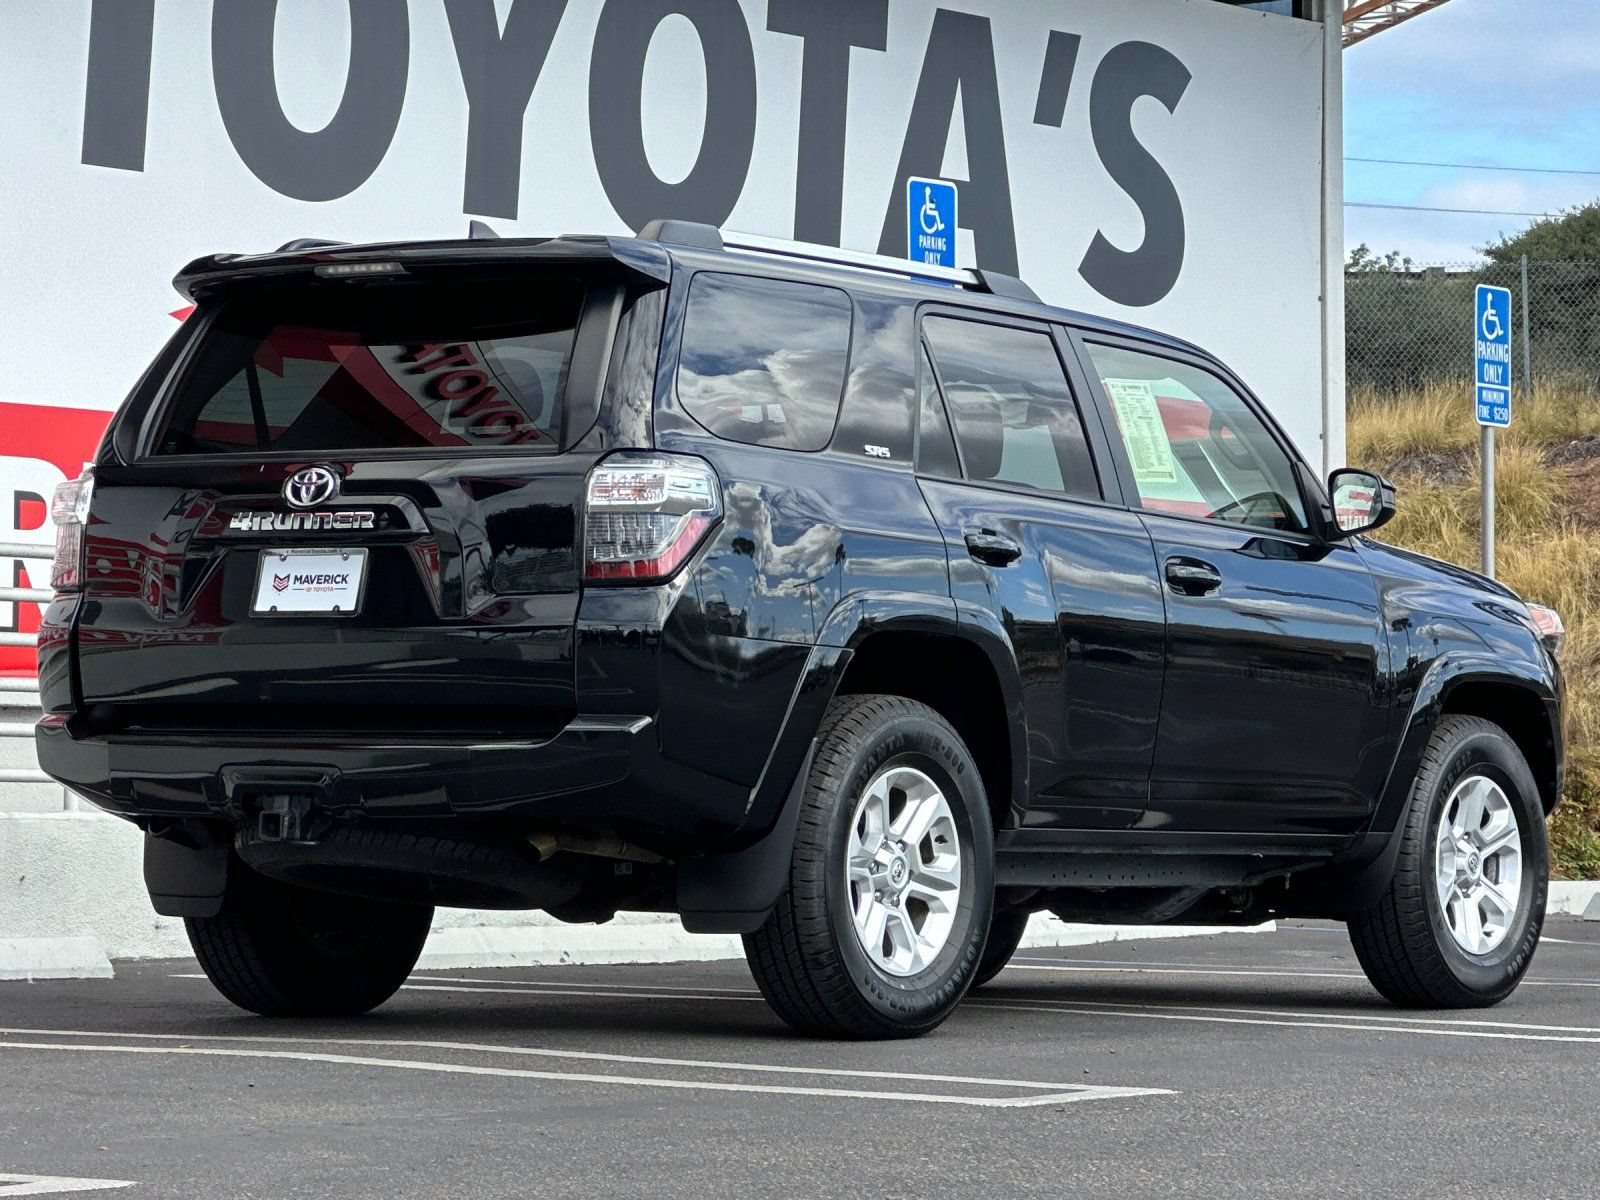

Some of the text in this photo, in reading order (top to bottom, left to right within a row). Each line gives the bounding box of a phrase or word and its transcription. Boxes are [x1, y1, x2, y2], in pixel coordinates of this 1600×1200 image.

[919, 234, 947, 252] PARKING
[924, 251, 941, 266] ONLY
[1478, 341, 1509, 363] PARKING
[1484, 363, 1503, 384] ONLY
[1482, 389, 1505, 405] MINIMUM
[1478, 404, 1508, 421] FINE $250
[864, 444, 891, 458] SR5
[229, 511, 376, 531] 4RUNNER
[293, 573, 350, 585] MAVERICK
